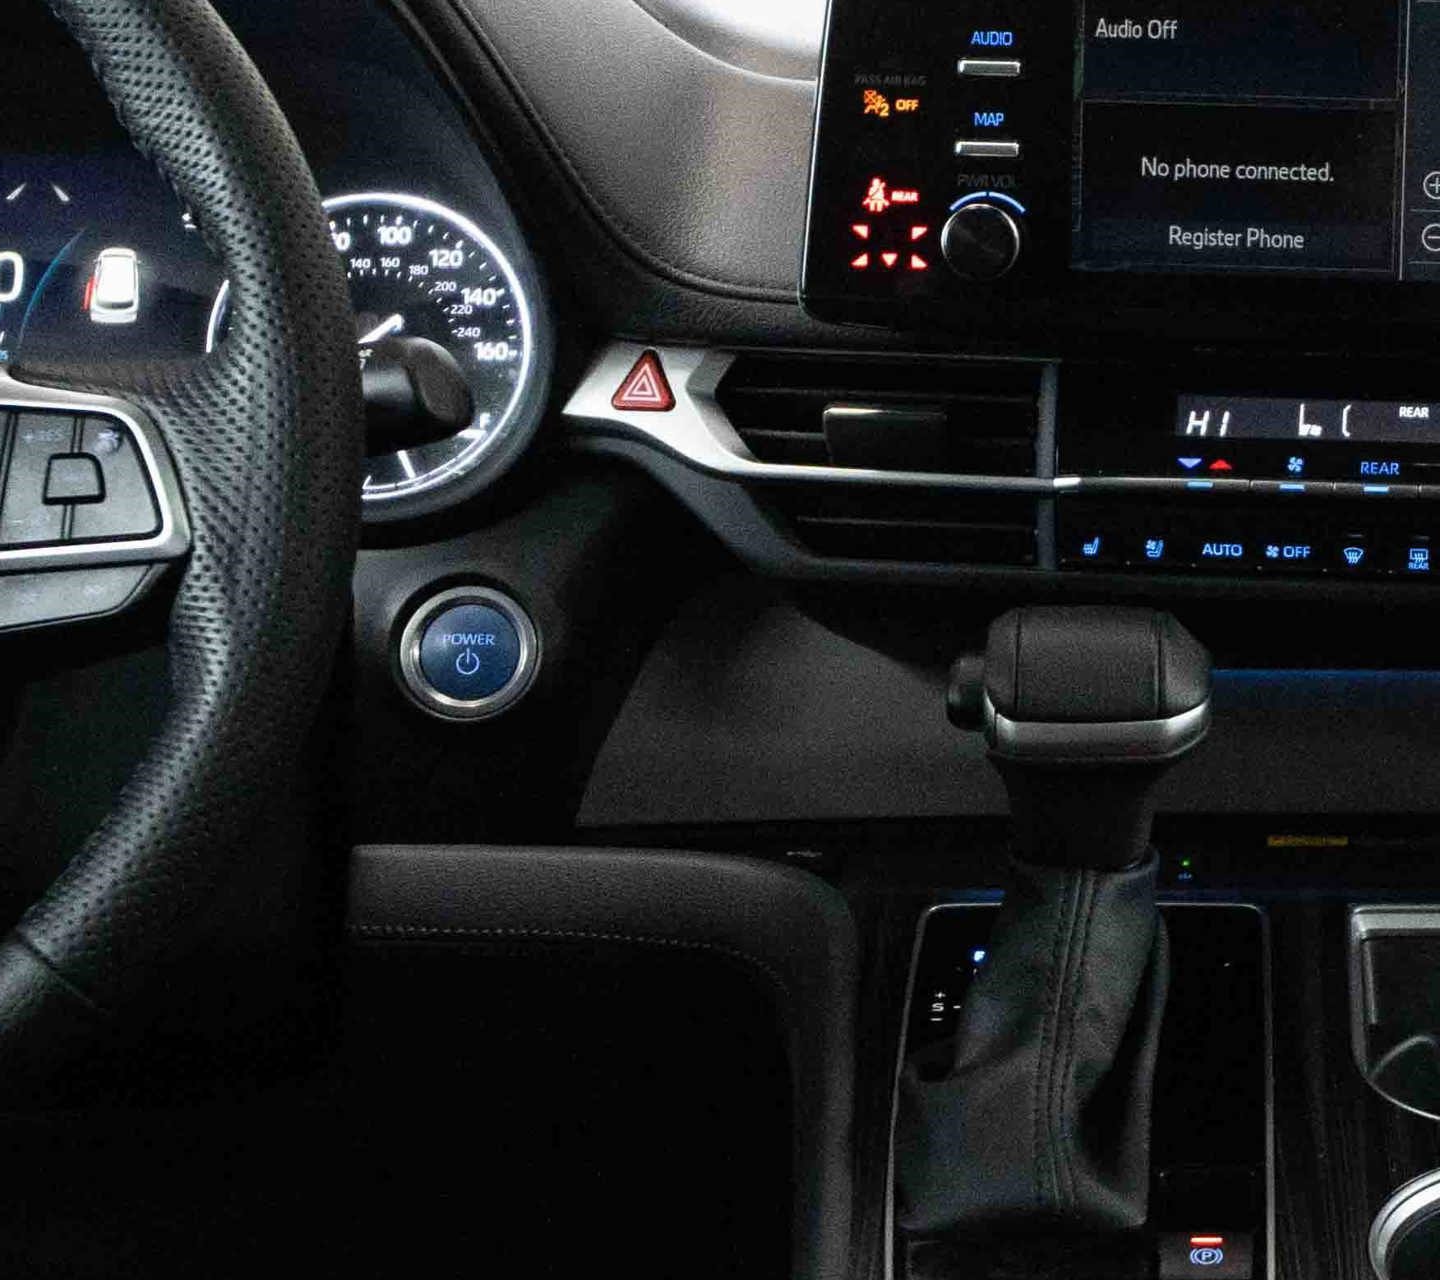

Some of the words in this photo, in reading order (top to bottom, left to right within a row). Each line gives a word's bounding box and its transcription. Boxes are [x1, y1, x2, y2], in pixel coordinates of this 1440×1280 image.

[1095, 18, 1142, 39] Audio
[1147, 19, 1178, 40] Off
[970, 31, 1013, 46] AUDIO
[895, 98, 919, 111] OFF
[973, 112, 1005, 128] MAP
[1141, 156, 1169, 177] No
[1174, 158, 1231, 181] phone
[1235, 162, 1335, 182] connected.
[332, 231, 351, 251] 0
[377, 226, 412, 245] 100
[1168, 225, 1242, 250] Register
[1246, 228, 1304, 249] Phone
[350, 258, 371, 269] 140
[380, 257, 401, 268] 160
[428, 248, 464, 268] 120
[408, 264, 429, 276] 180
[434, 281, 457, 292] 200
[460, 287, 497, 306] 140
[450, 304, 473, 315] 220
[458, 327, 481, 337] 240
[474, 341, 509, 361] 160
[1399, 405, 1430, 418] REAR
[1360, 461, 1400, 476] REAR
[1201, 543, 1243, 557] AUTO
[1283, 545, 1311, 559] OFF
[442, 632, 495, 646] POWER
